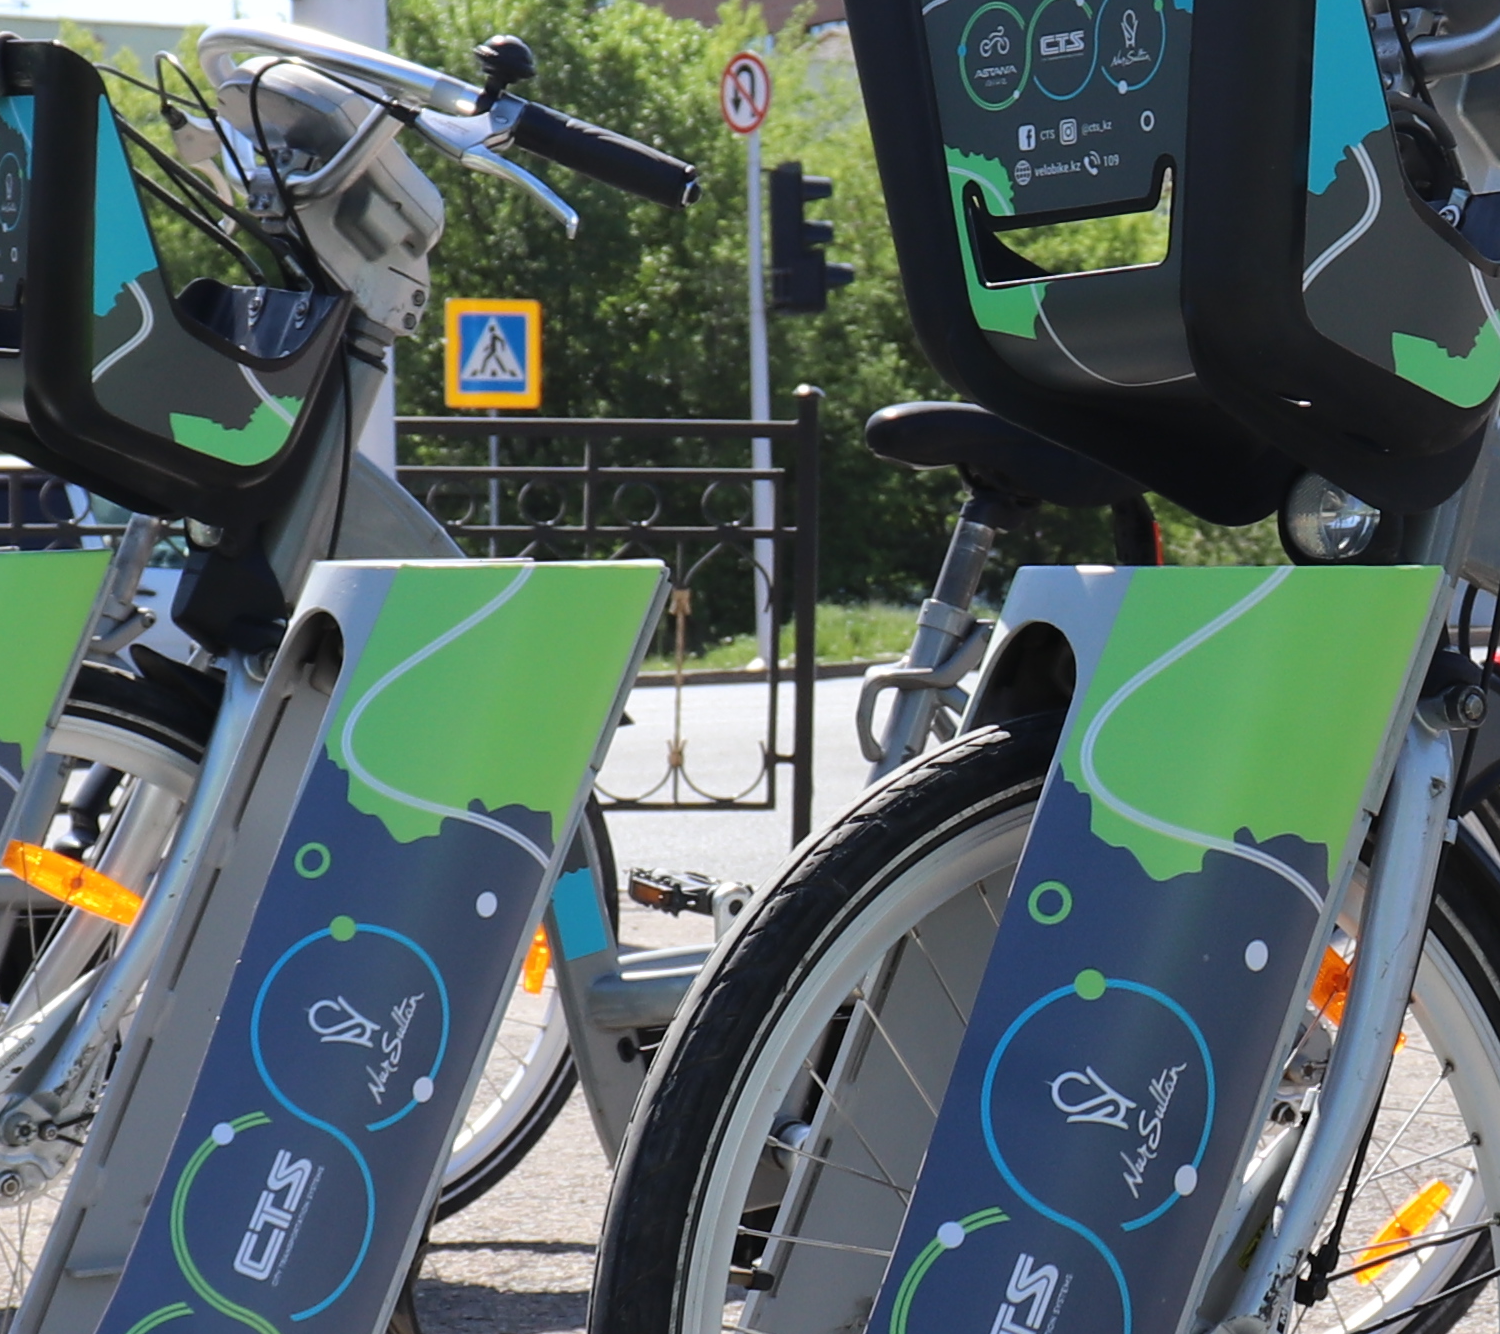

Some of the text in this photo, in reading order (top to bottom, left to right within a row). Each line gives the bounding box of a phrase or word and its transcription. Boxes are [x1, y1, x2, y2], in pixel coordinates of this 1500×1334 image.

[1040, 31, 1085, 56] CTS
[1040, 129, 1055, 141] CTS
[1103, 154, 1120, 167] 109
[233, 1148, 313, 1281] CTS
[1051, 1273, 1073, 1317] SYSTEMS
